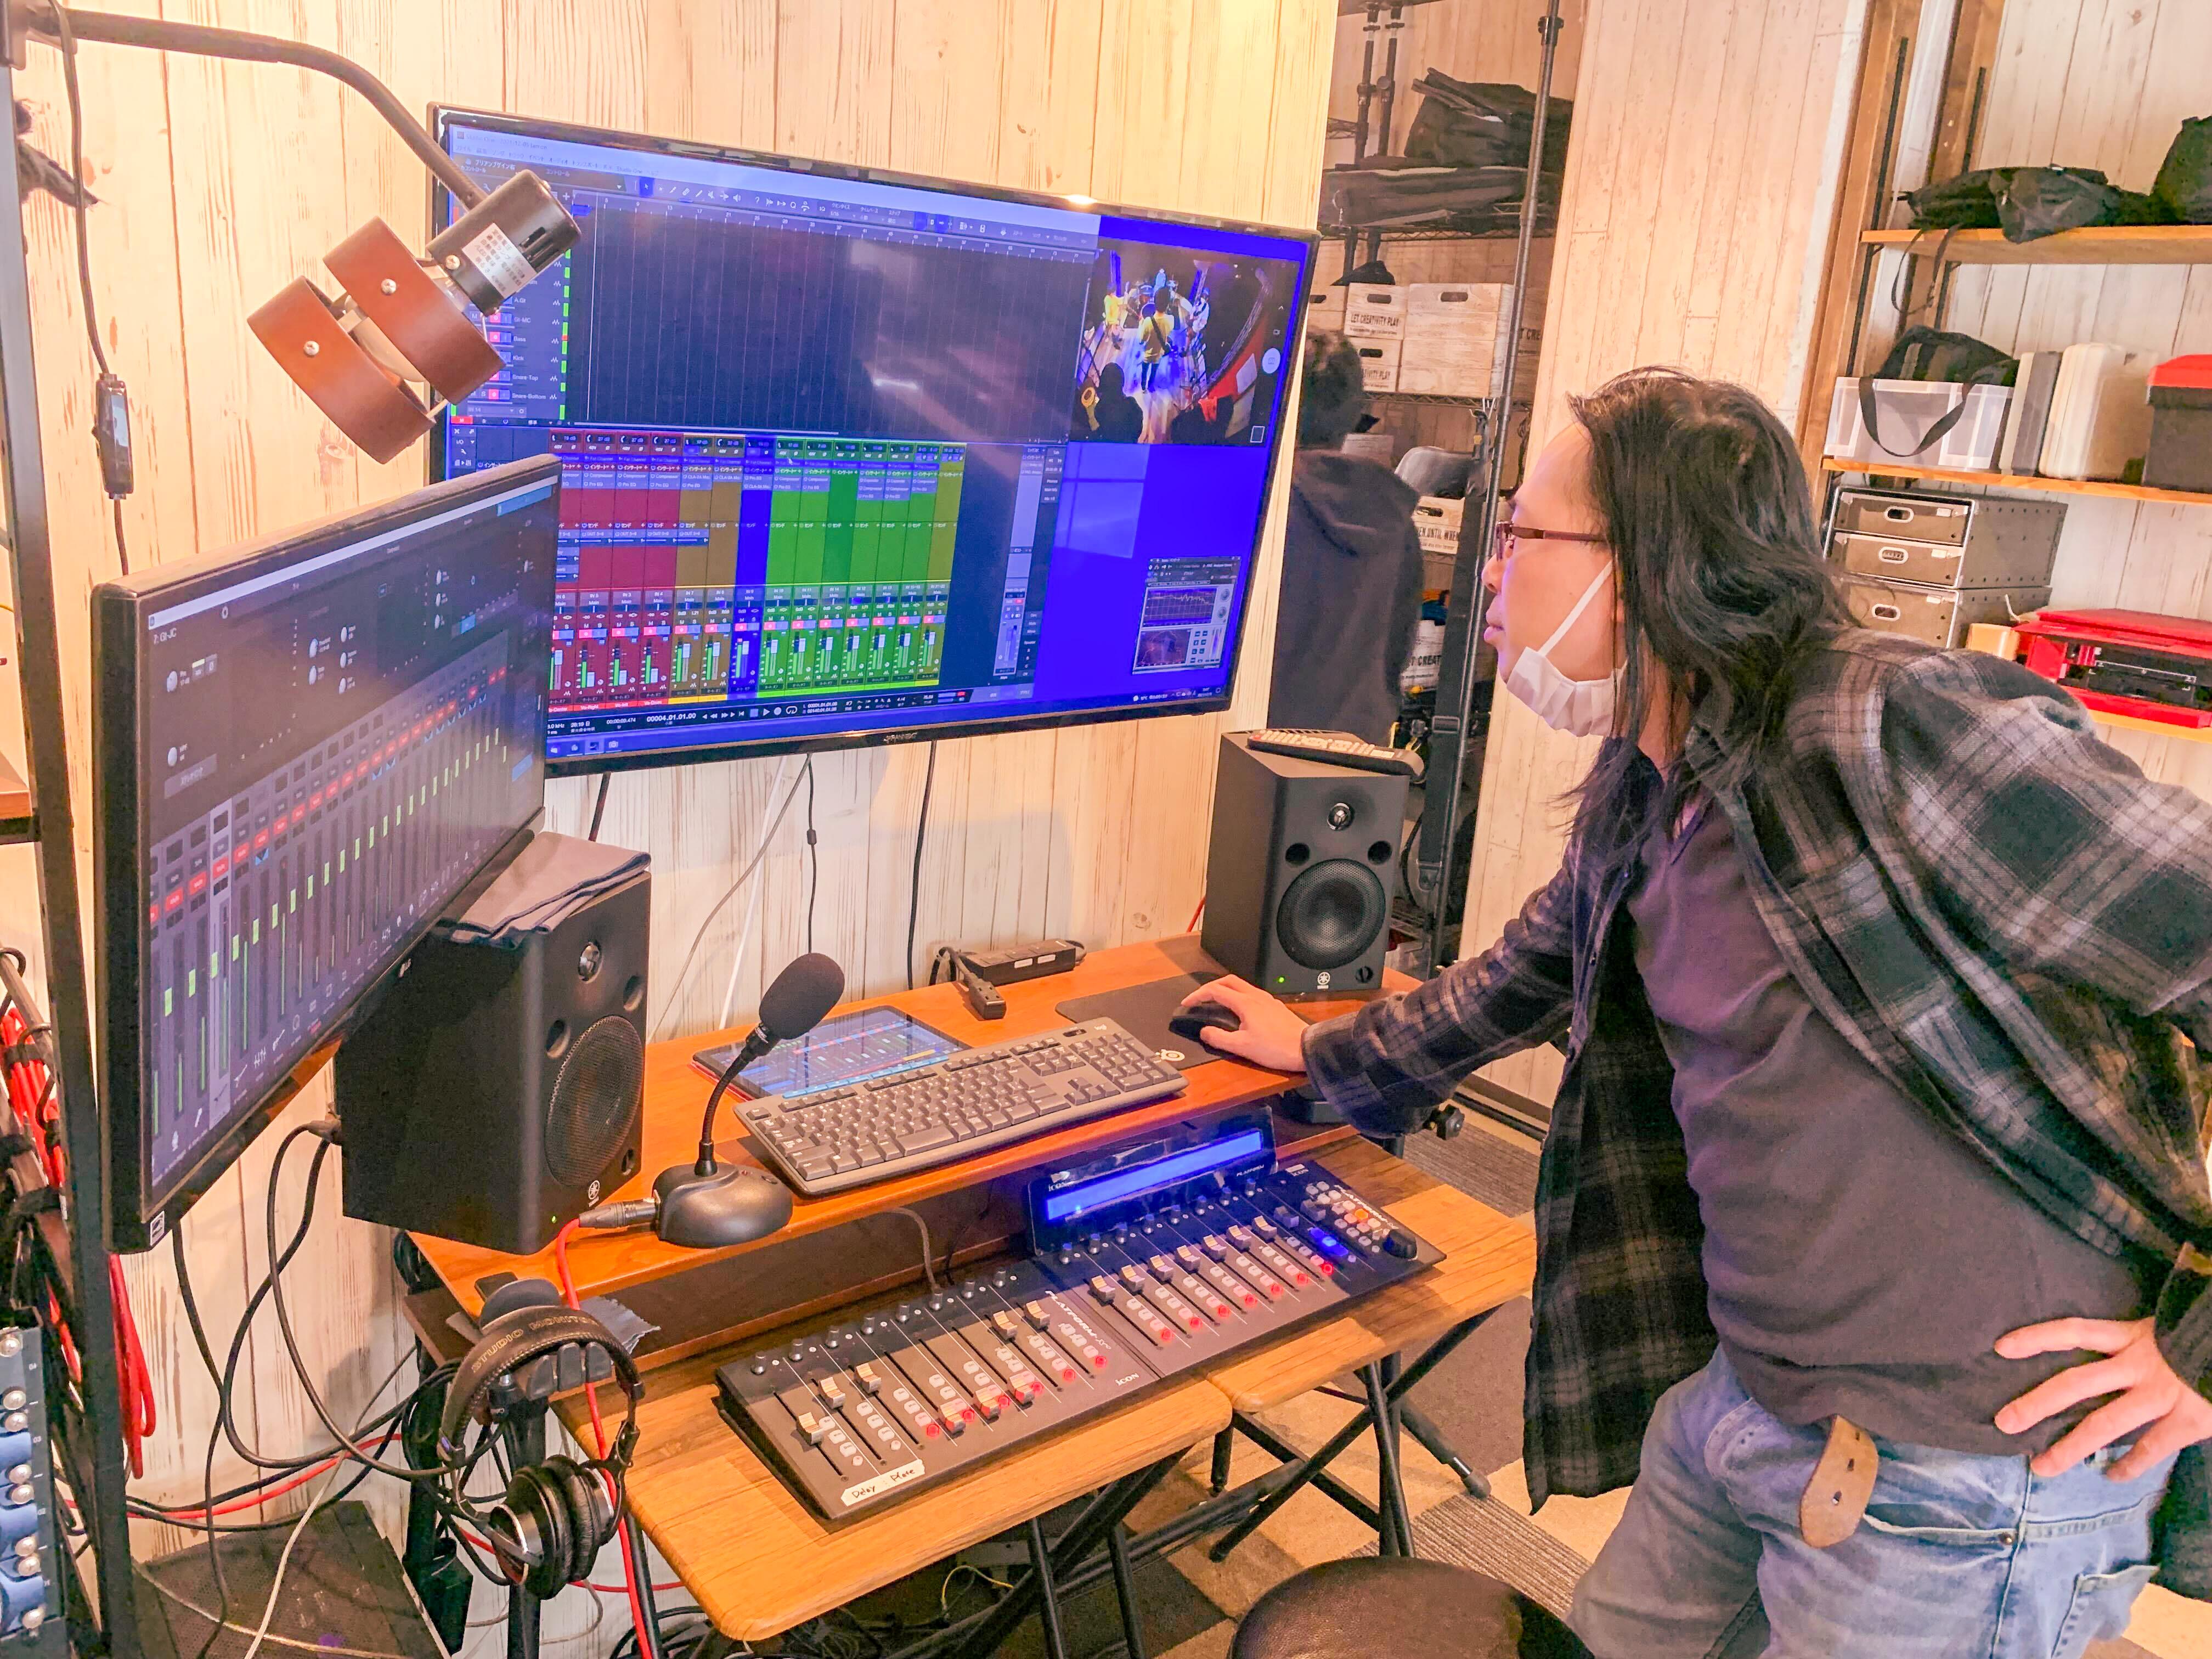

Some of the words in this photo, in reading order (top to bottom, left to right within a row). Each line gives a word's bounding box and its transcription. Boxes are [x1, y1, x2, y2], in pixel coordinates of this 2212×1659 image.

[1360, 314, 1387, 326] CREATIVITY
[1387, 317, 1400, 327] PLAY
[646, 713, 697, 723] 00004.01.01.00
[1045, 1290, 1097, 1337] PLATFORM
[471, 1328, 524, 1373] STUDIO
[528, 1315, 600, 1330] MONITOR
[1115, 1373, 1139, 1386] iCON
[32, 1436, 42, 1444] 03
[890, 1469, 916, 1482] Plate
